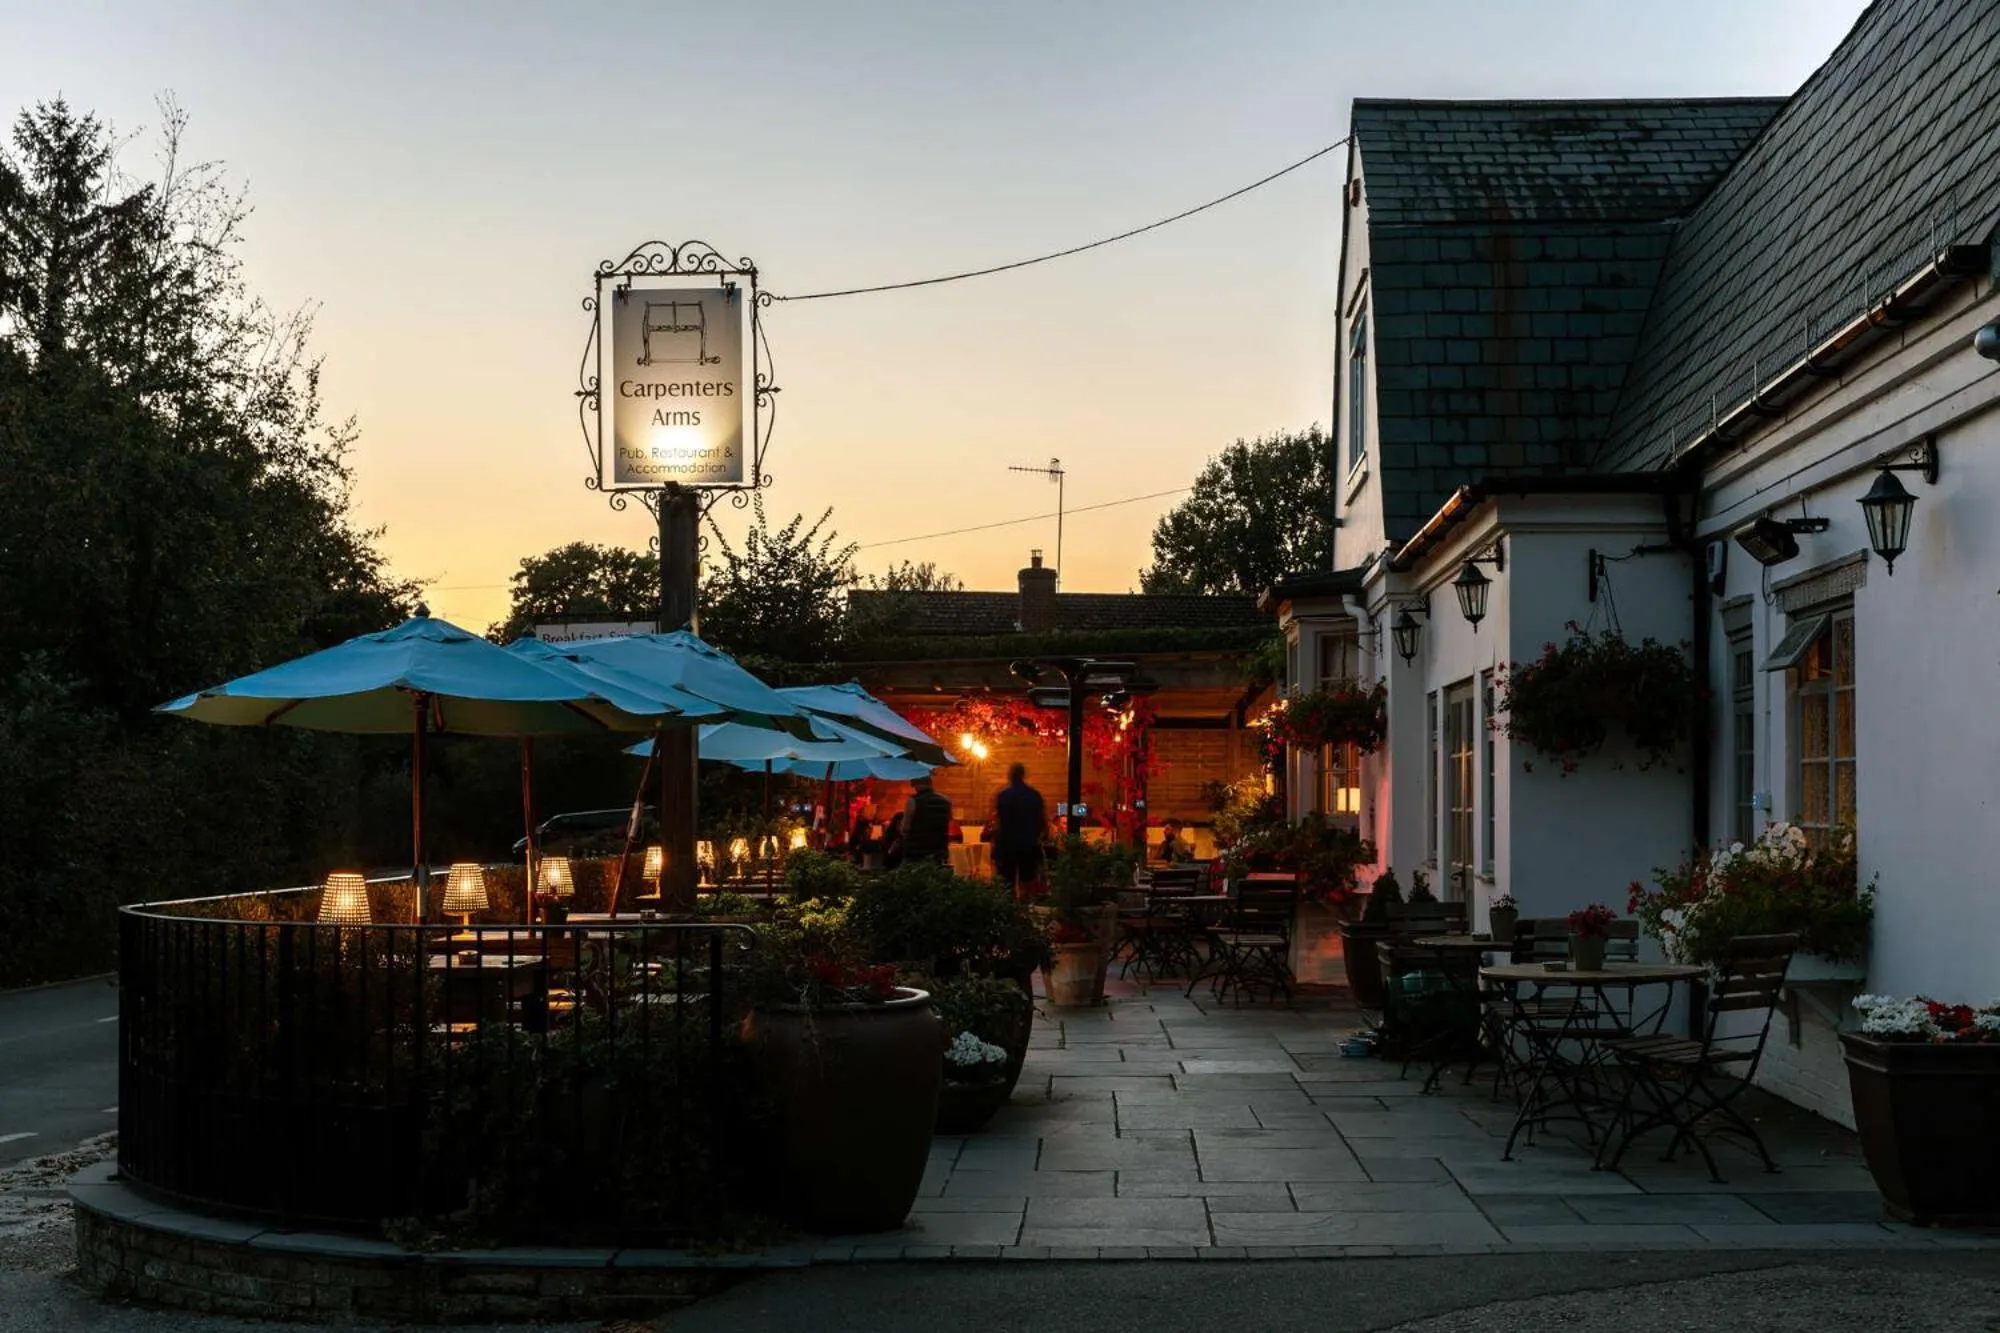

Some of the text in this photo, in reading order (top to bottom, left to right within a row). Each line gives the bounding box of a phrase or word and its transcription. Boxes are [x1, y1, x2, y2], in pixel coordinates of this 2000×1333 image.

[620, 380, 734, 400] Carpenters
[651, 408, 701, 426] Arms
[620, 447, 734, 460] Pub, Restaurant &
[627, 463, 727, 475] Accommodation
